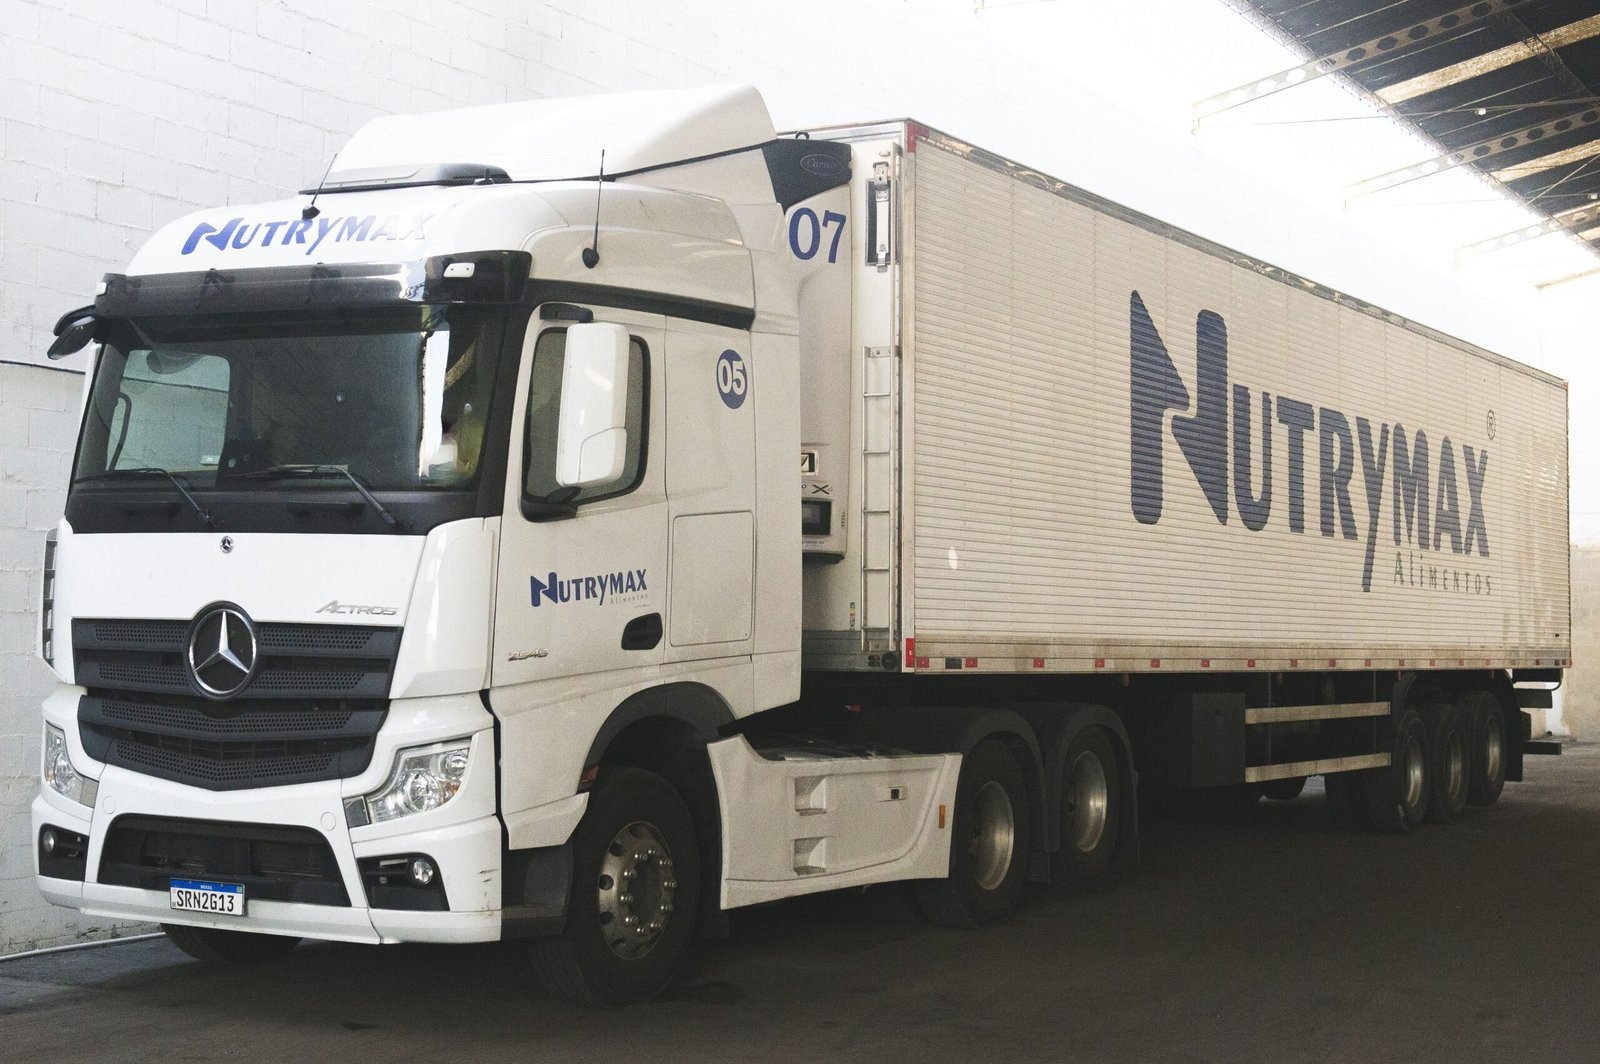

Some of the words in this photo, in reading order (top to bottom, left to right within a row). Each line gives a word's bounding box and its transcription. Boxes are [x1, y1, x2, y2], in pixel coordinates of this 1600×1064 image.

[180, 213, 435, 256] NUTRYMAX
[789, 207, 847, 264] 07
[718, 358, 746, 396] 05
[1130, 290, 1490, 592] NUTRYMAX
[530, 568, 648, 607] NUTRYMAX
[315, 600, 398, 616] ACTROS
[176, 889, 235, 913] SRN2G13
